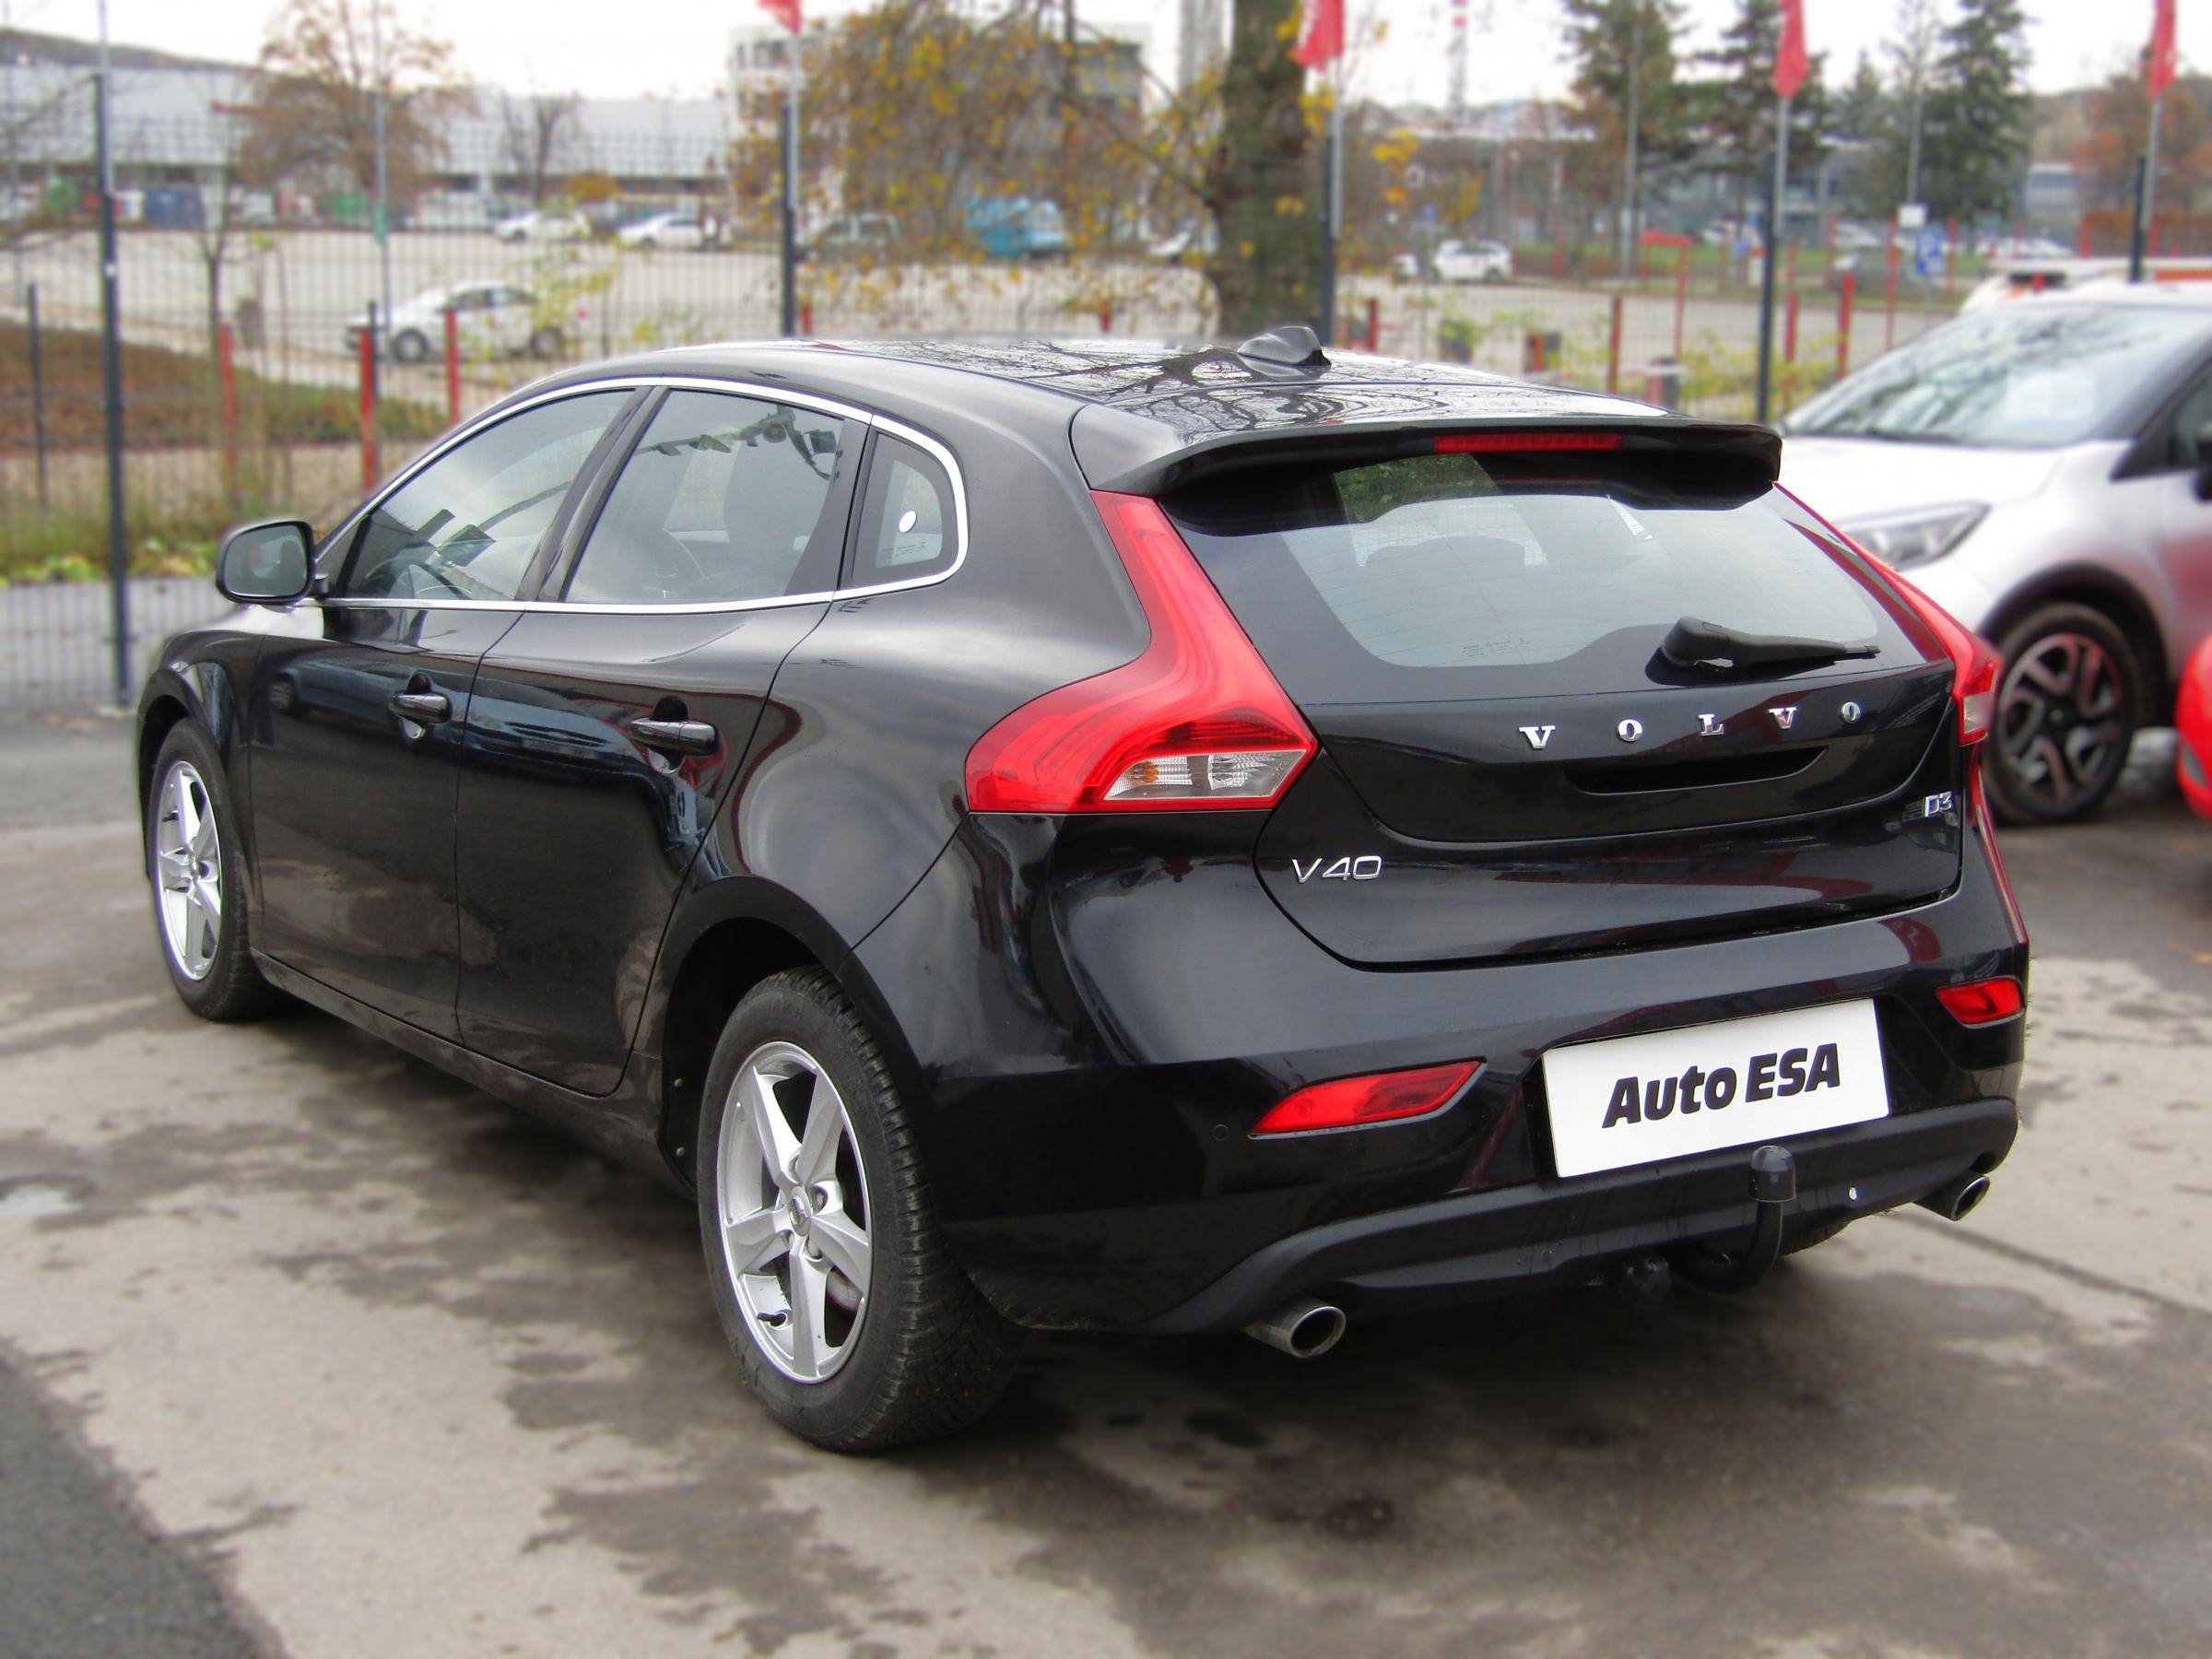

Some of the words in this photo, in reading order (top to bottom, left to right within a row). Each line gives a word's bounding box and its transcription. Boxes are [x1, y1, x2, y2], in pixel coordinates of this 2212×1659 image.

[1519, 701, 1862, 749] VOLVO
[1924, 791, 1952, 818] D3
[1292, 855, 1382, 883] V40
[1602, 1065, 1736, 1129] Auto
[1746, 1042, 1841, 1103] ESA
